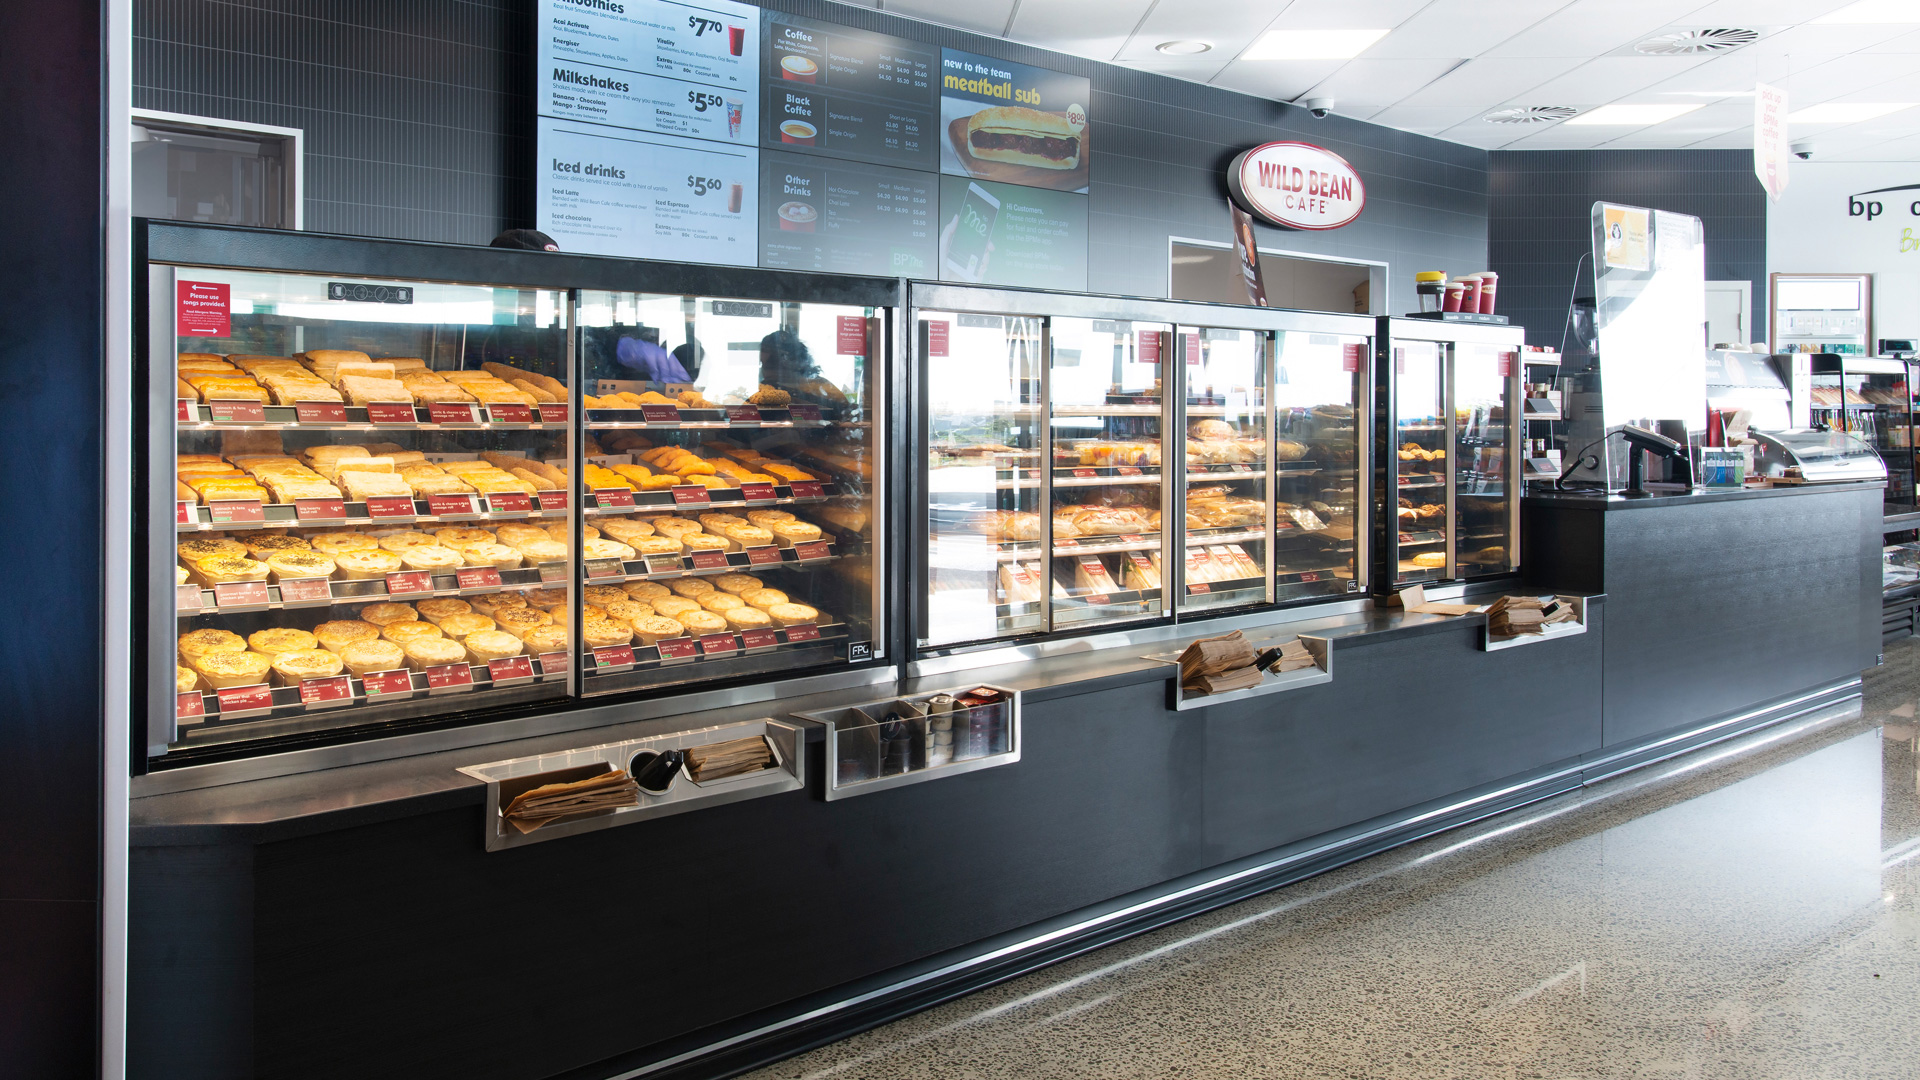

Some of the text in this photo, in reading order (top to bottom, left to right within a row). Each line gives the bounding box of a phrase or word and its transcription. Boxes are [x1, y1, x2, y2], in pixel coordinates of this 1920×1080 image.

[556, 0, 625, 14] oothies
[553, 17, 590, 30] Acai Activate
[599, 12, 619, 21] blended
[629, 18, 648, 27] coconut
[784, 28, 813, 42] Coffee
[553, 37, 580, 47] Energiser
[656, 37, 675, 47] Vitality
[656, 56, 673, 64] Extras
[829, 53, 851, 63] Signature
[851, 56, 864, 65] Blend
[879, 53, 891, 62] Small
[894, 57, 912, 65] Medium
[829, 64, 858, 75] Single Origin
[944, 58, 1012, 80] new to the team
[552, 68, 630, 92] Milkshakes
[552, 83, 571, 91] Shakes
[651, 99, 676, 108] remember
[944, 74, 1041, 106] meatball sub
[552, 92, 607, 106] Banana Chocolate
[786, 93, 811, 107] Black
[552, 100, 608, 115] Mango Strawberry
[655, 108, 672, 116] Extras
[784, 103, 812, 117] Coffee
[828, 111, 863, 123] Signature Blend
[888, 113, 900, 121] Short
[905, 116, 917, 125] Long
[828, 128, 857, 139] Single Origin
[552, 158, 626, 179] Iced drinks
[551, 173, 569, 181] Classic
[570, 175, 585, 183] drinks
[585, 177, 602, 185] served
[652, 185, 669, 193] vanilla
[785, 174, 810, 186] Other
[1258, 160, 1352, 202] WILD BEAN
[551, 187, 580, 196] Iced Latte
[783, 184, 812, 197] Drinks
[836, 187, 860, 196] Chocolate
[667, 200, 690, 209] Espresso
[1006, 202, 1044, 215] Hi Customers,
[1285, 194, 1325, 214] CAFE
[1849, 195, 1883, 221] bp
[551, 212, 592, 222] Iced chocolate
[1006, 212, 1070, 229] Please note you can pay
[654, 223, 671, 231] Extras
[1015, 224, 1026, 232] fuel
[1038, 227, 1052, 235] order
[1052, 229, 1069, 237] coffee
[190, 292, 208, 300] Please
[183, 299, 199, 307] tongs
[852, 644, 869, 656] FPG
